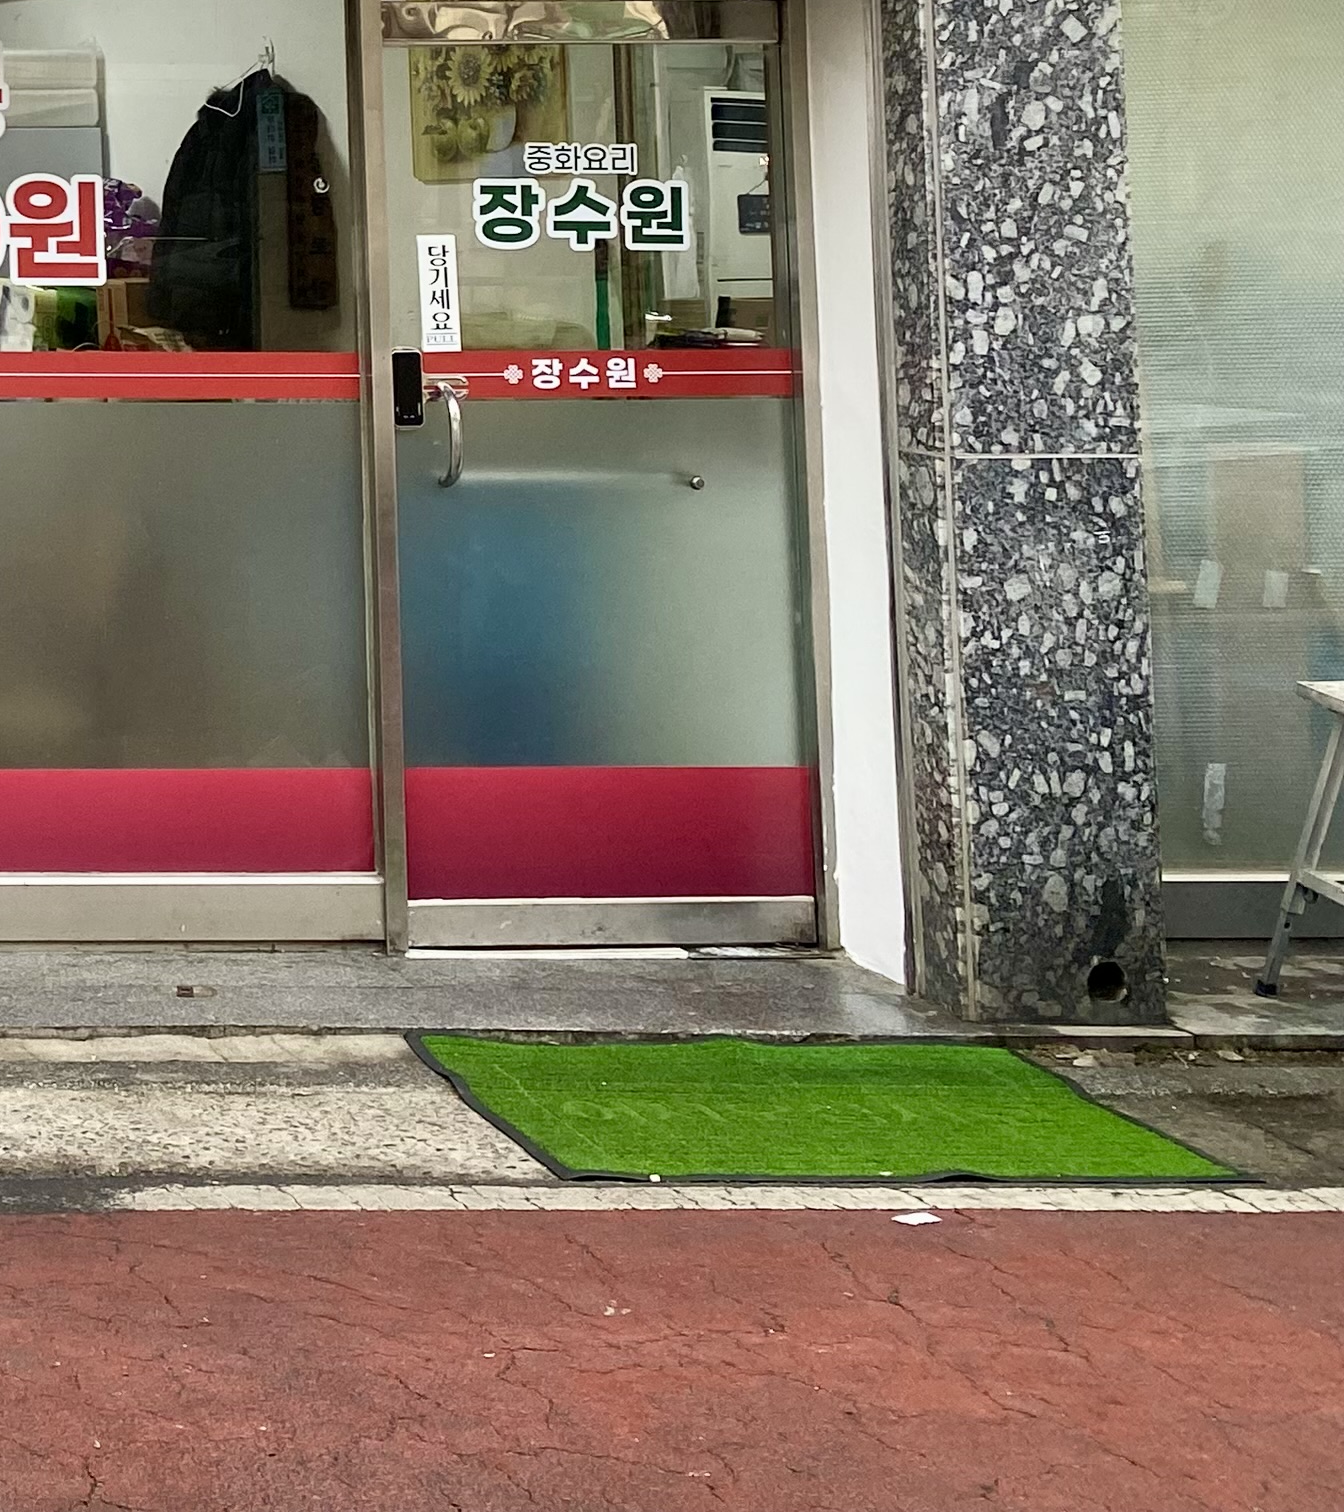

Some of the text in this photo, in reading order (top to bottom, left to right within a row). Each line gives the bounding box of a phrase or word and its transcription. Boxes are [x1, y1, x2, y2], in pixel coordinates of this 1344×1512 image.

[525, 144, 638, 174] 중화요리
[478, 183, 685, 246] 장수원
[428, 244, 454, 330] 당기세요
[426, 334, 457, 343] PULL
[530, 357, 637, 390] 장수원
